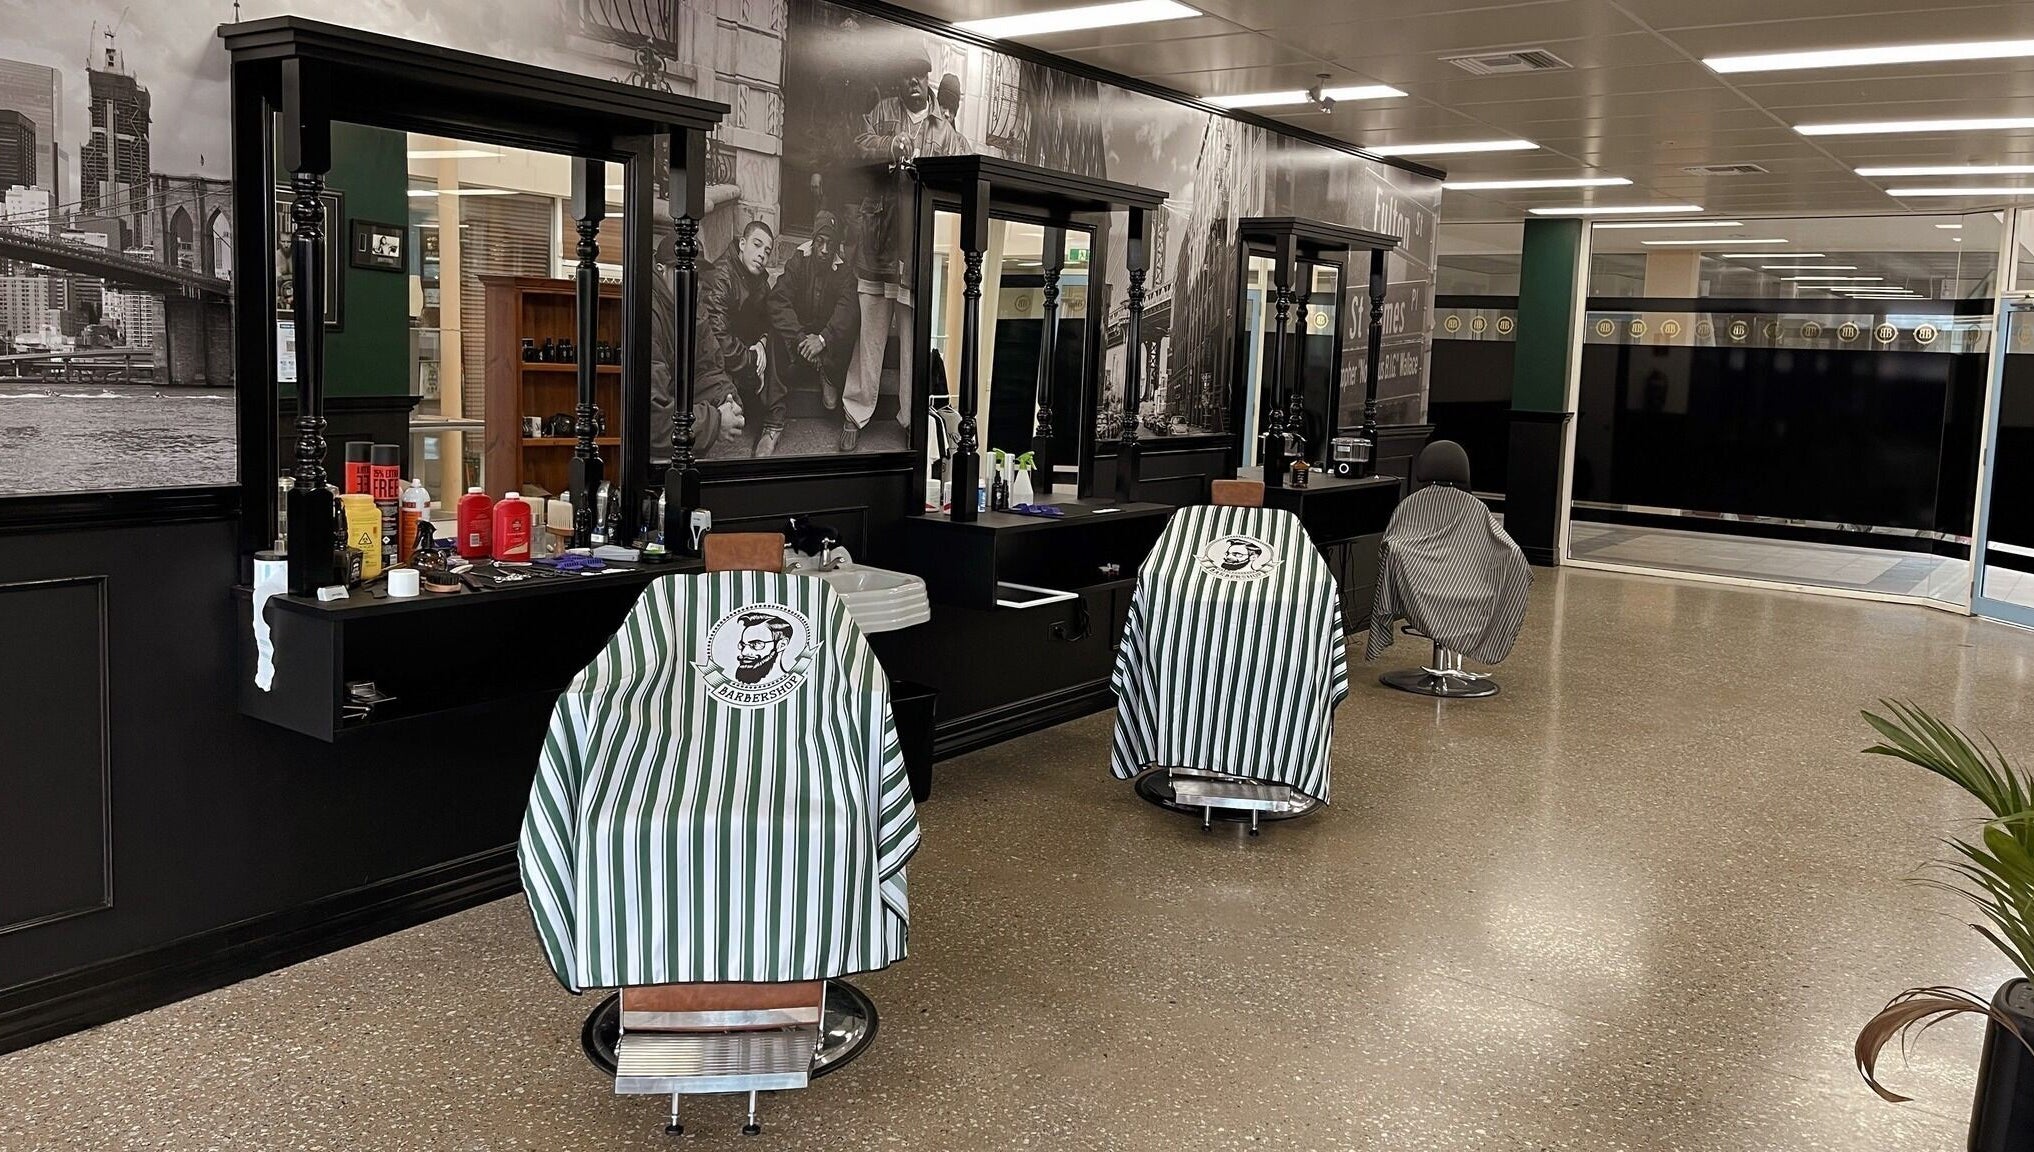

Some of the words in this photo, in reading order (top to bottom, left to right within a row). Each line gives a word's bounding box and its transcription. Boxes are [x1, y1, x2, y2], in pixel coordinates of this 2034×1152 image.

[1373, 186, 1411, 251] Fulton
[1415, 211, 1424, 237] St
[1349, 295, 1364, 340] St
[373, 478, 399, 498] FREE
[718, 675, 798, 702] BARBERSHOP
